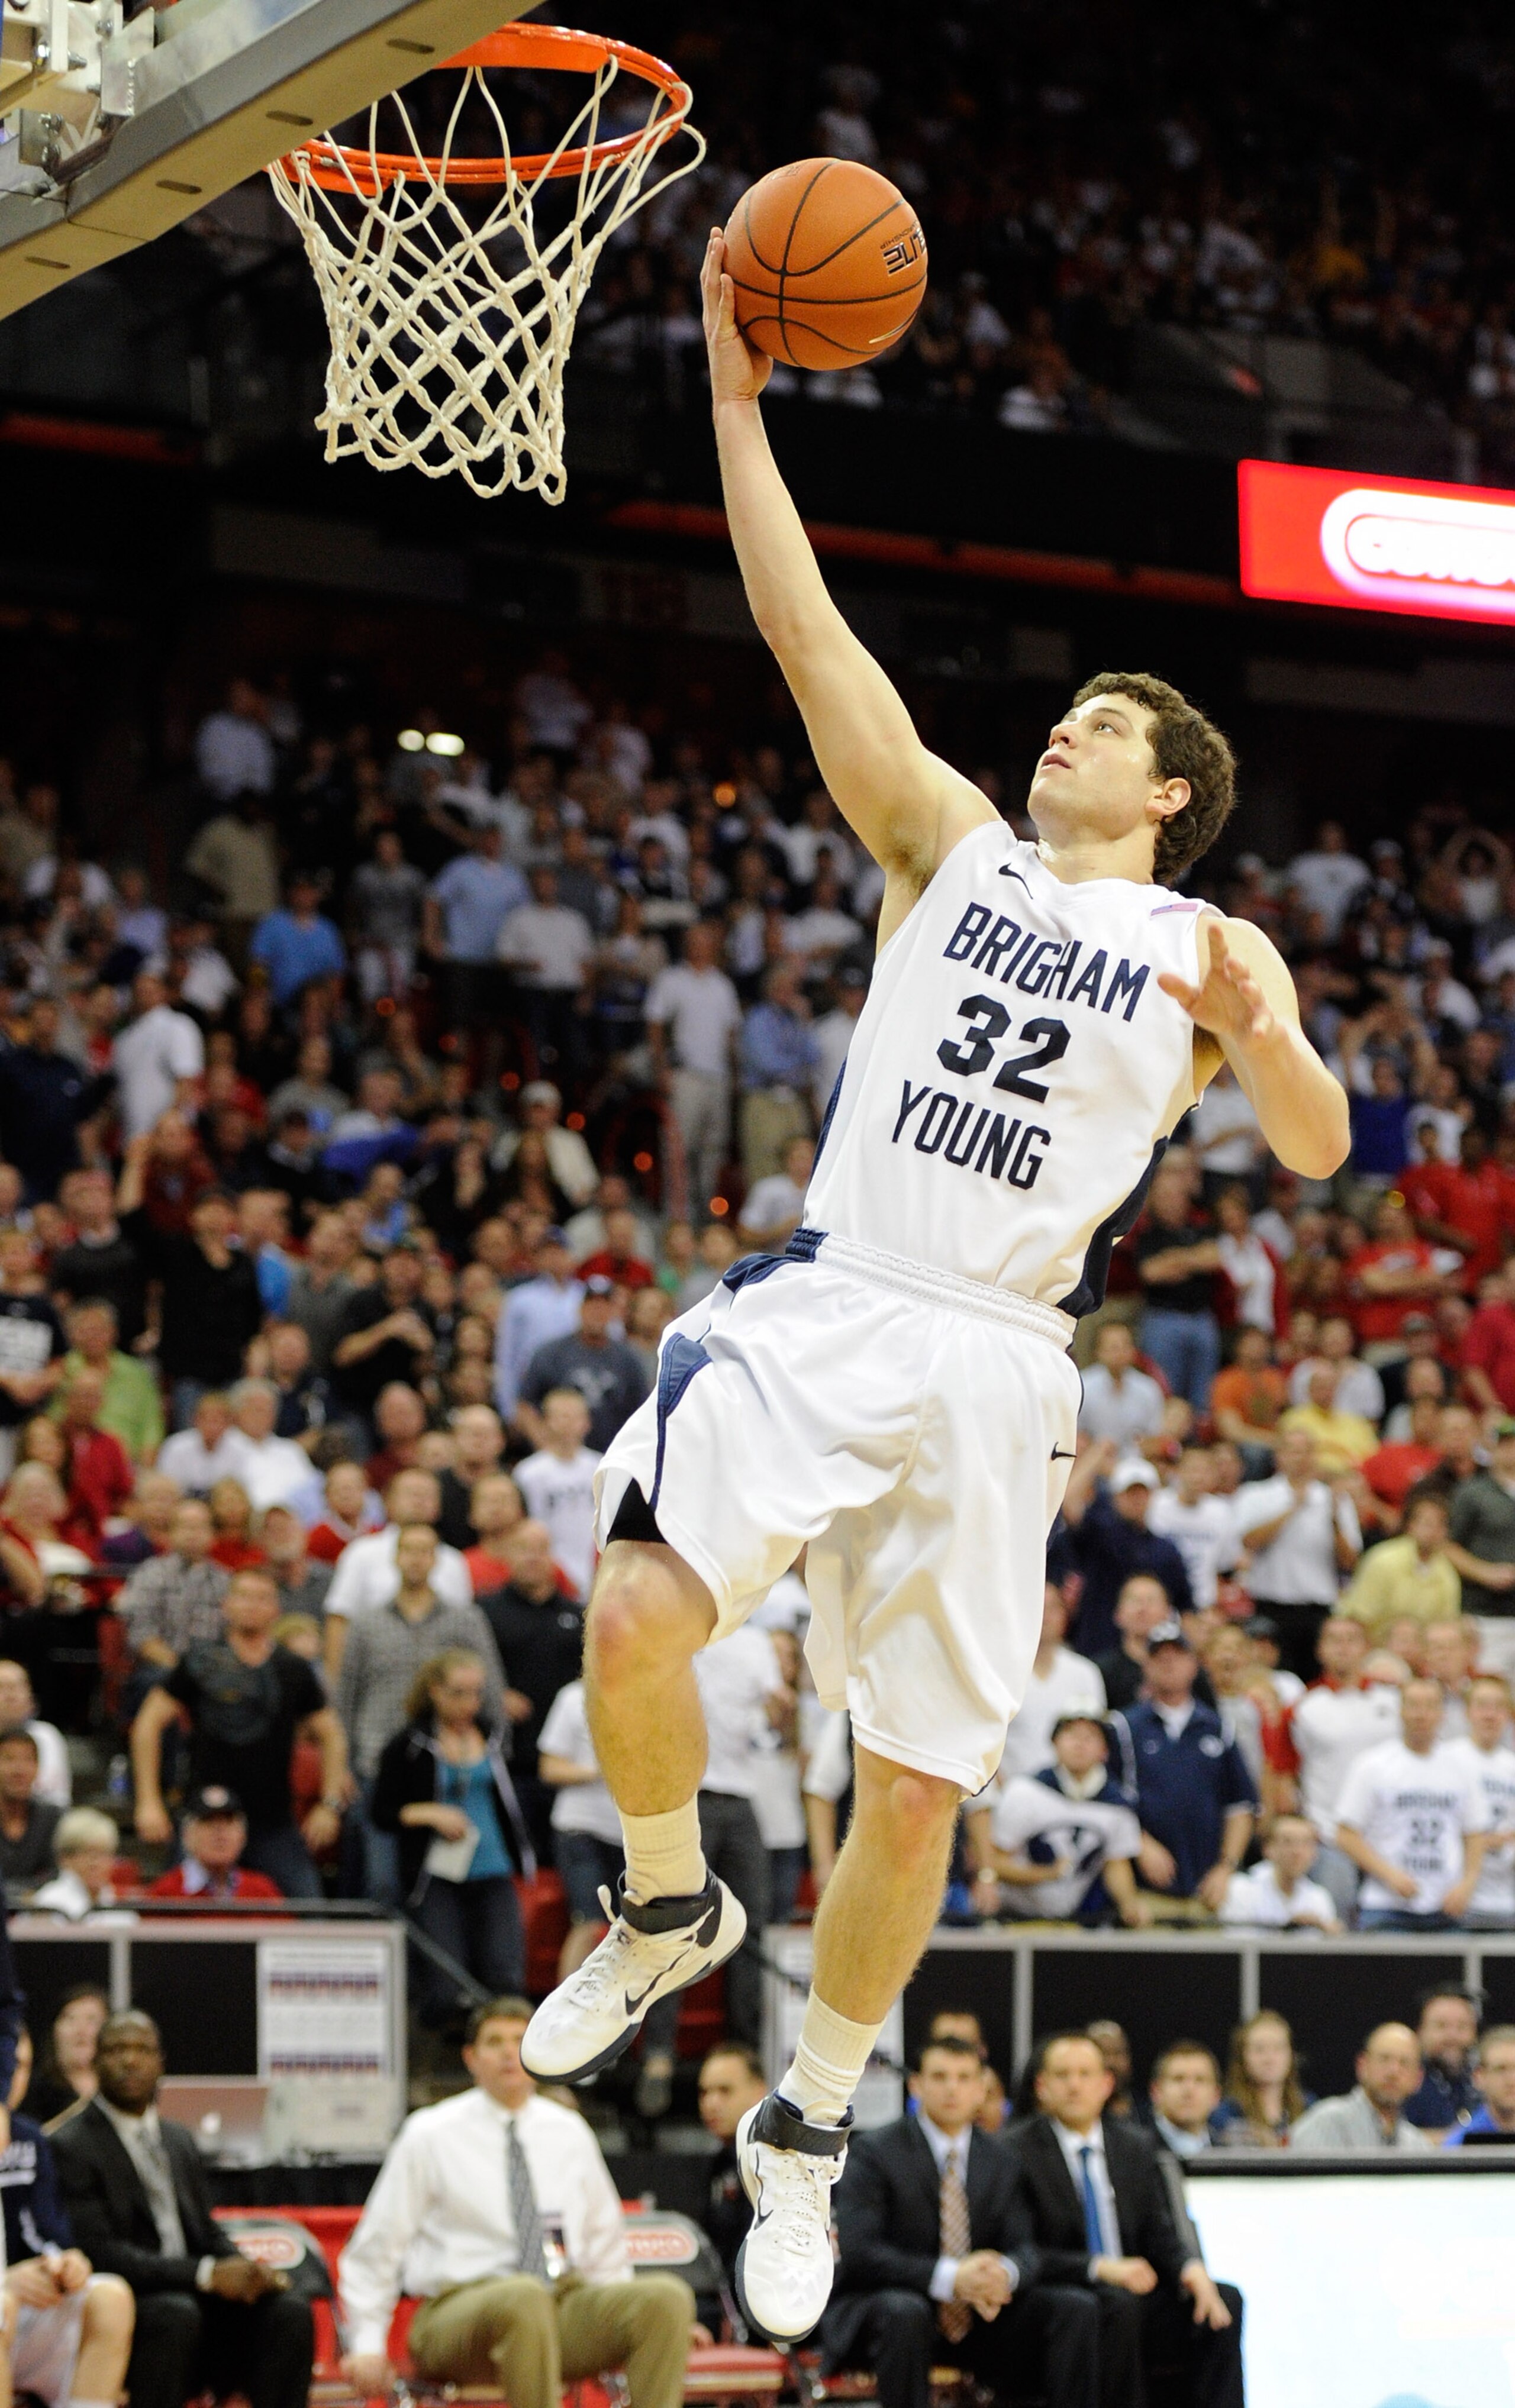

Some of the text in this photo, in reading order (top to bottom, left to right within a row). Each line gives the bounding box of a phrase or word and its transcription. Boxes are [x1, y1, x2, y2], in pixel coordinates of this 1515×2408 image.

[943, 901, 1151, 1023] BRIGHAM
[936, 993, 1071, 1104] 32
[892, 1079, 1052, 1190] YOUNG
